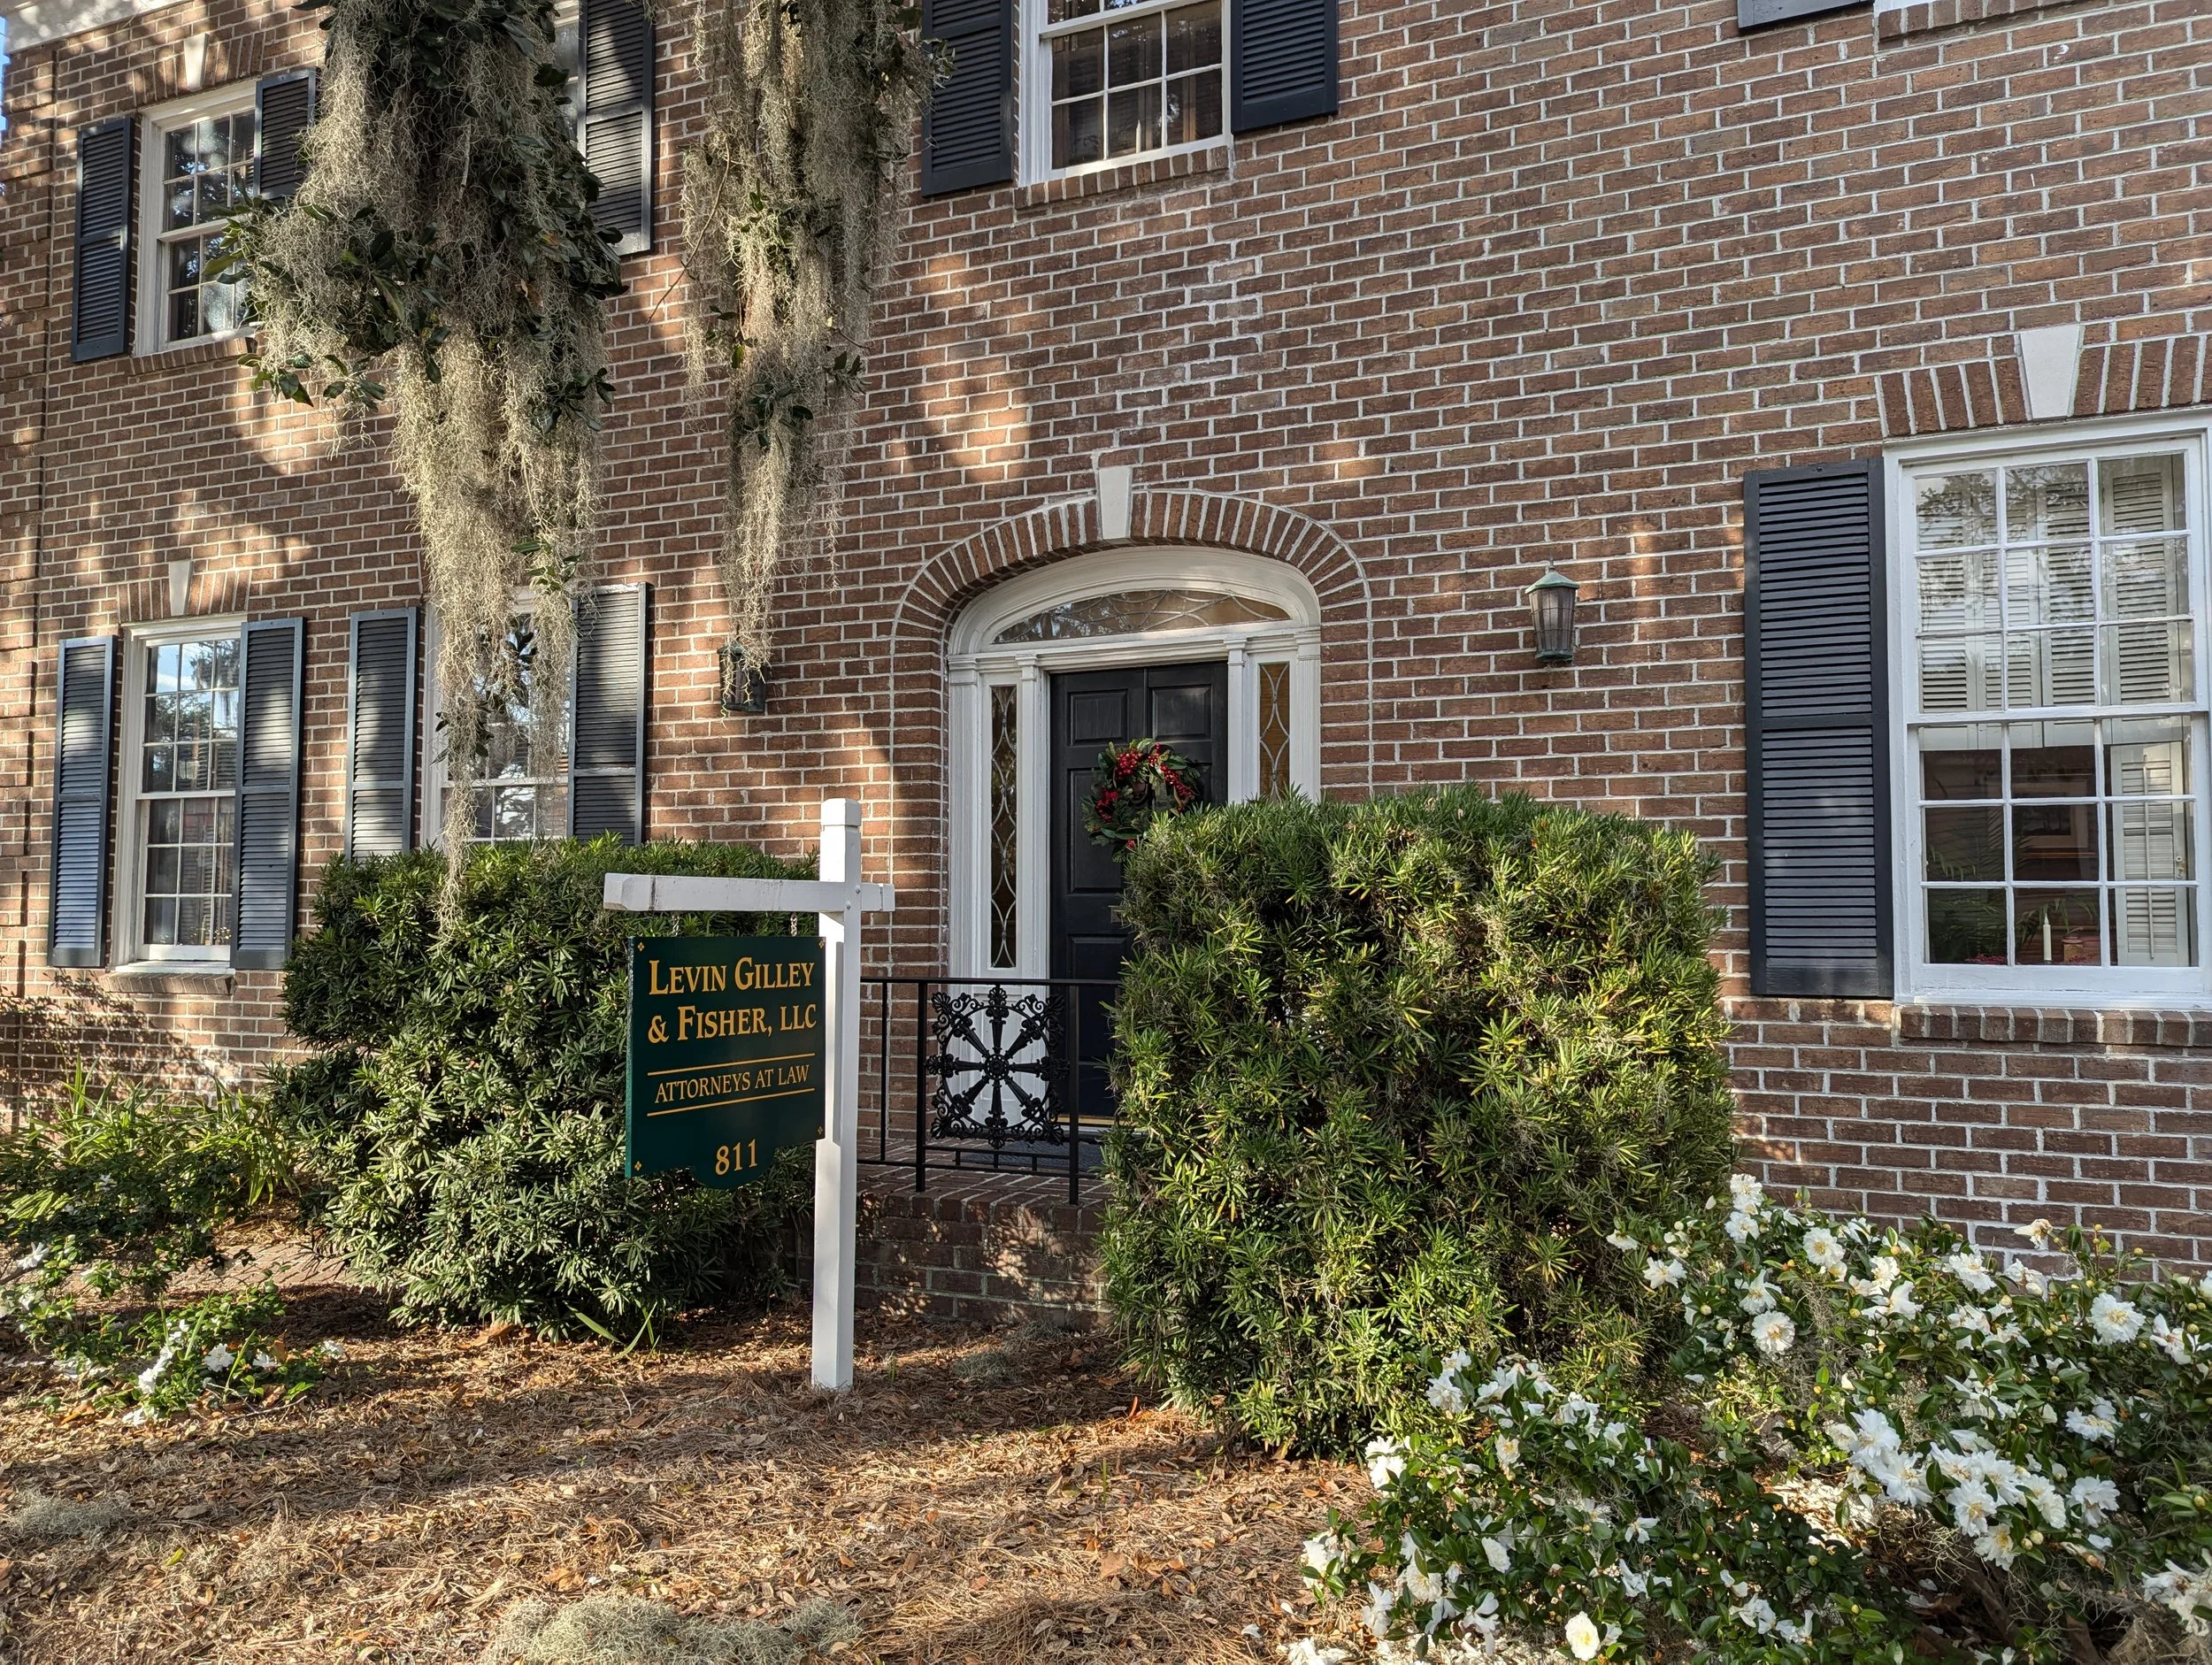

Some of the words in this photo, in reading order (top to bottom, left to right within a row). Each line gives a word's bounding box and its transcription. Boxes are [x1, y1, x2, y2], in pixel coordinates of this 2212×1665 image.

[649, 959, 727, 995] LEVIN
[734, 956, 815, 991] GILLEY
[648, 1015, 670, 1044] &
[677, 1005, 772, 1041] FISHER,
[780, 1003, 817, 1032] LLC
[654, 1071, 751, 1104] ATTORNEYS
[755, 1068, 774, 1089] AT
[778, 1064, 810, 1086] LAW
[715, 1139, 758, 1176] 811
